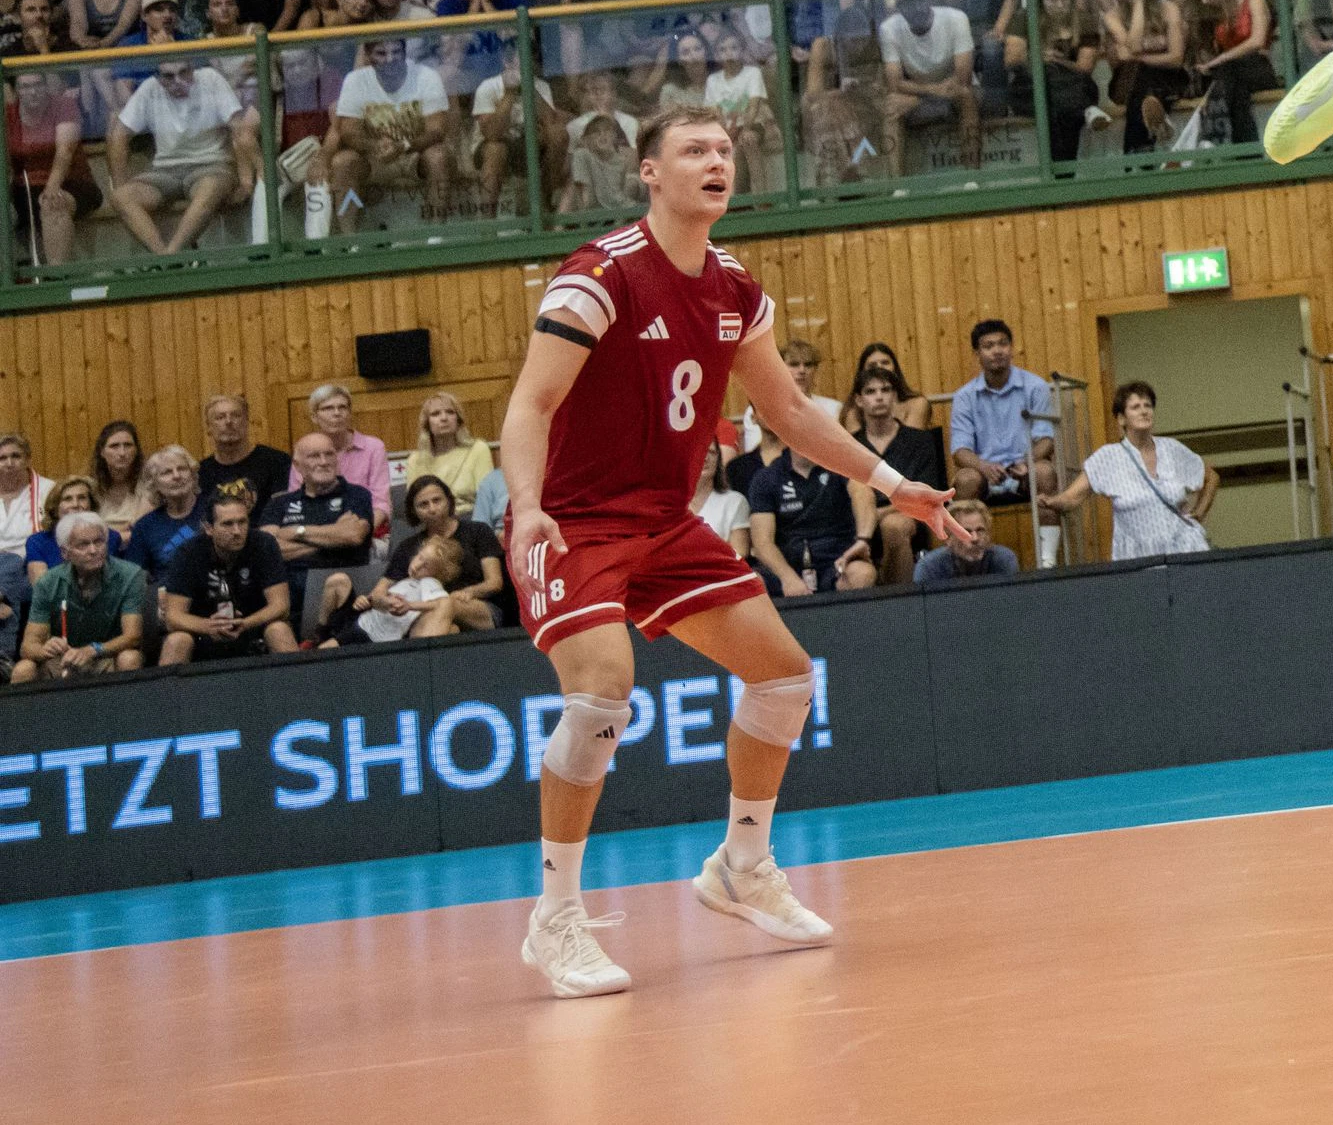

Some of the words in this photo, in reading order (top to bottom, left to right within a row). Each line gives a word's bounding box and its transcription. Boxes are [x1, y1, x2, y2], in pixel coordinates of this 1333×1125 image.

[668, 359, 703, 432] 8
[550, 578, 566, 602] 8
[0, 728, 242, 844] ETZT
